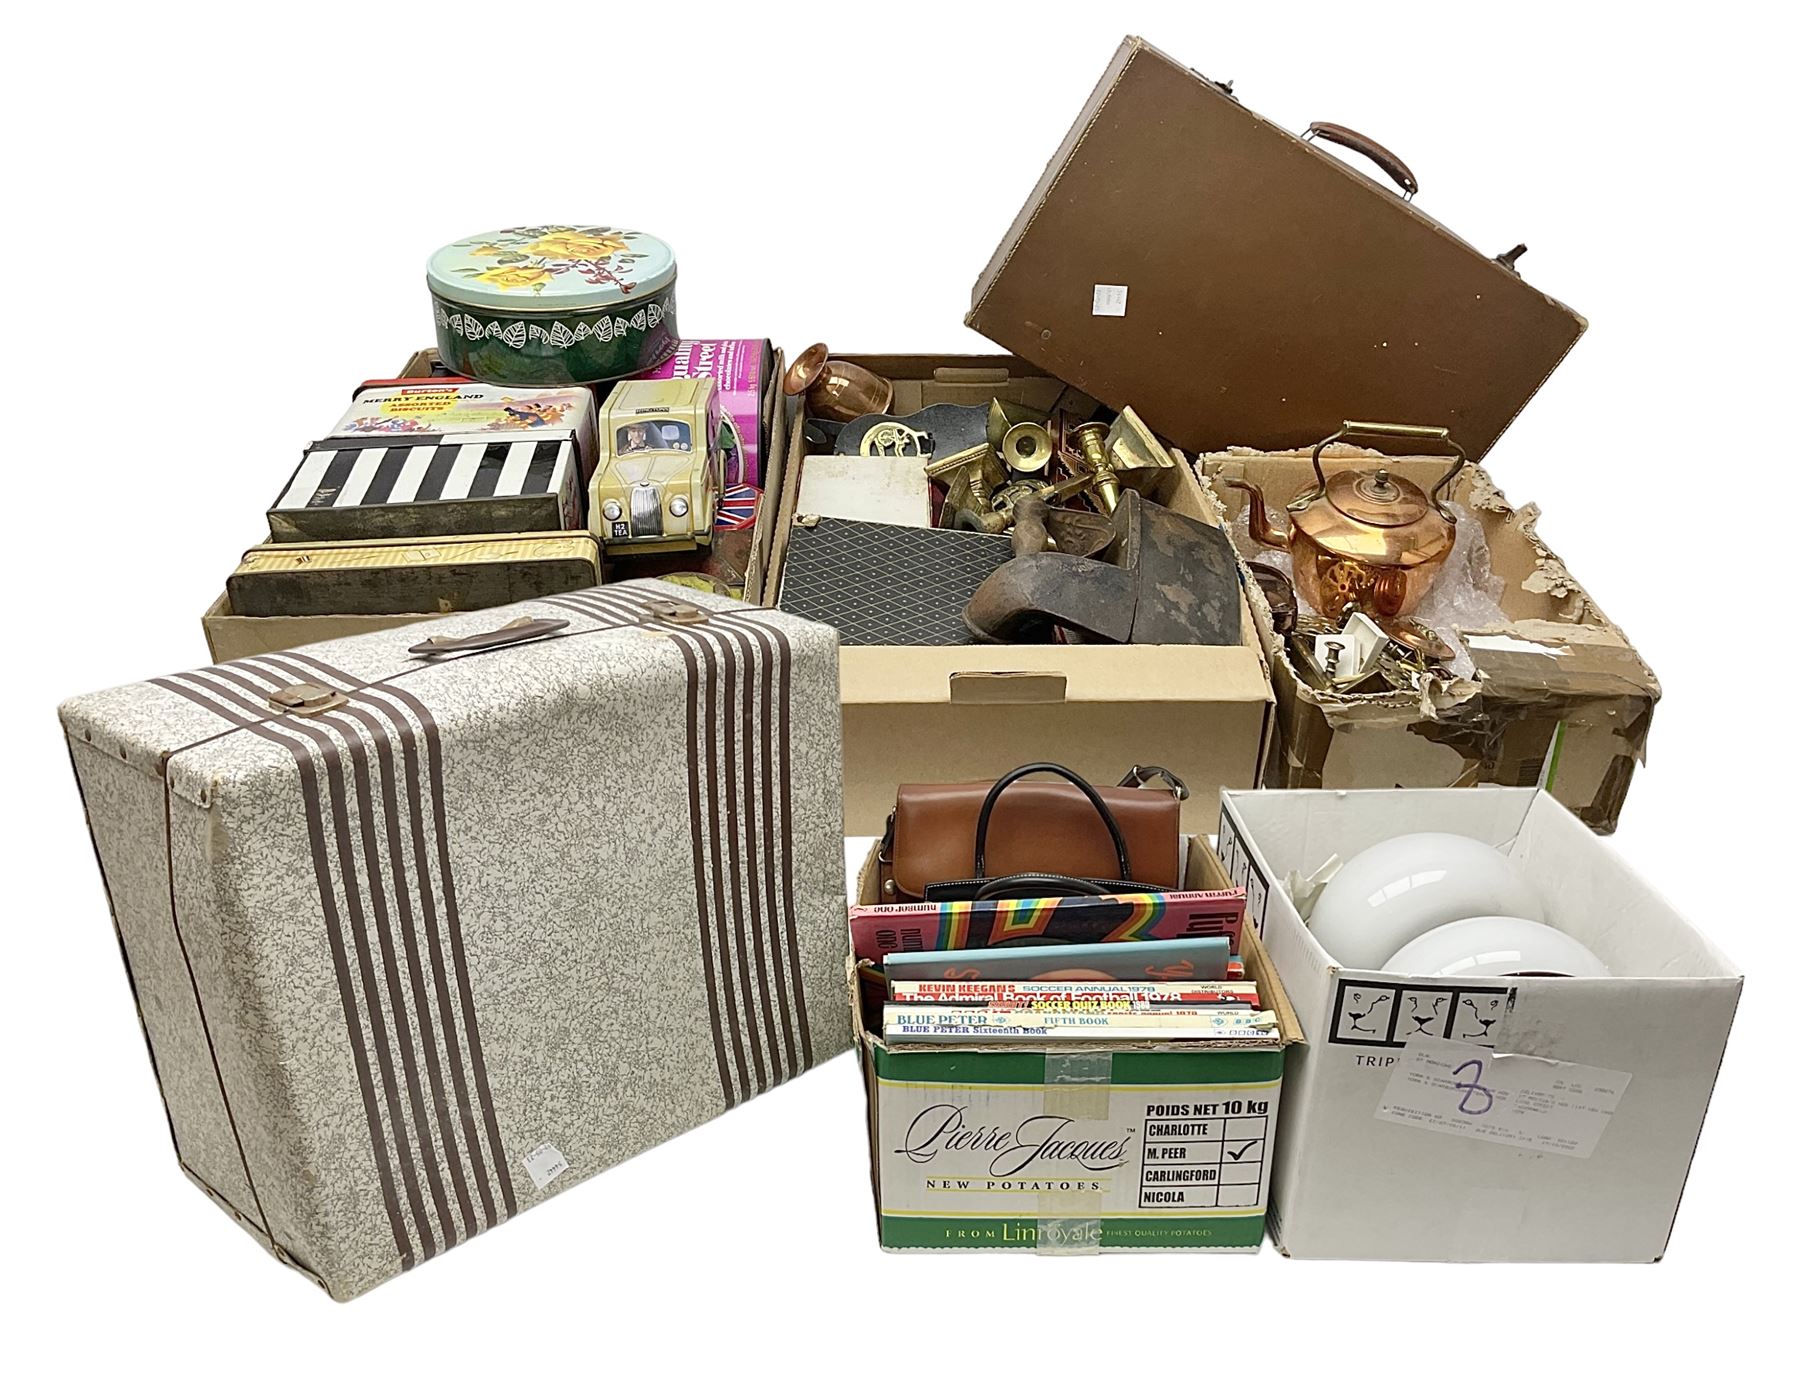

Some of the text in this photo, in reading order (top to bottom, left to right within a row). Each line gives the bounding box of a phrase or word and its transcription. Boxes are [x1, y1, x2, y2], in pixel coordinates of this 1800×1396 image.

[363, 393, 484, 404] MERRY ENGLAND
[614, 529, 627, 537] TEA
[918, 984, 956, 993] KEVIN
[902, 992, 1182, 1001] The Admiral Book of Football 1978
[1031, 1000, 1071, 1009] SOCCER
[1072, 1000, 1099, 1009] QUIZ
[1100, 1000, 1130, 1009] BOOK
[897, 1014, 936, 1026] BLUE
[938, 1014, 988, 1026] PETER
[1044, 1017, 1076, 1025] FIFTH
[1079, 1017, 1109, 1025] BOOK
[902, 1025, 930, 1033] BLUE
[933, 1026, 970, 1034] PETER
[973, 1026, 1019, 1035] Sixteenth
[1356, 1054, 1400, 1068] TRIP
[1146, 1100, 1269, 1116] POIDS NET 10 kg
[1148, 1123, 1208, 1137] CHARLOTTE
[895, 1104, 1012, 1163] Pierre
[989, 1115, 1131, 1177] Jacques
[1147, 1147, 1187, 1159] M. PEER
[1145, 1169, 1217, 1182] CARLINGFORD
[926, 1179, 1100, 1191] NEW POTATOES
[1143, 1191, 1185, 1203] NICOLA
[945, 1229, 996, 1238] FROM
[1002, 1222, 1104, 1244] Linroyale
